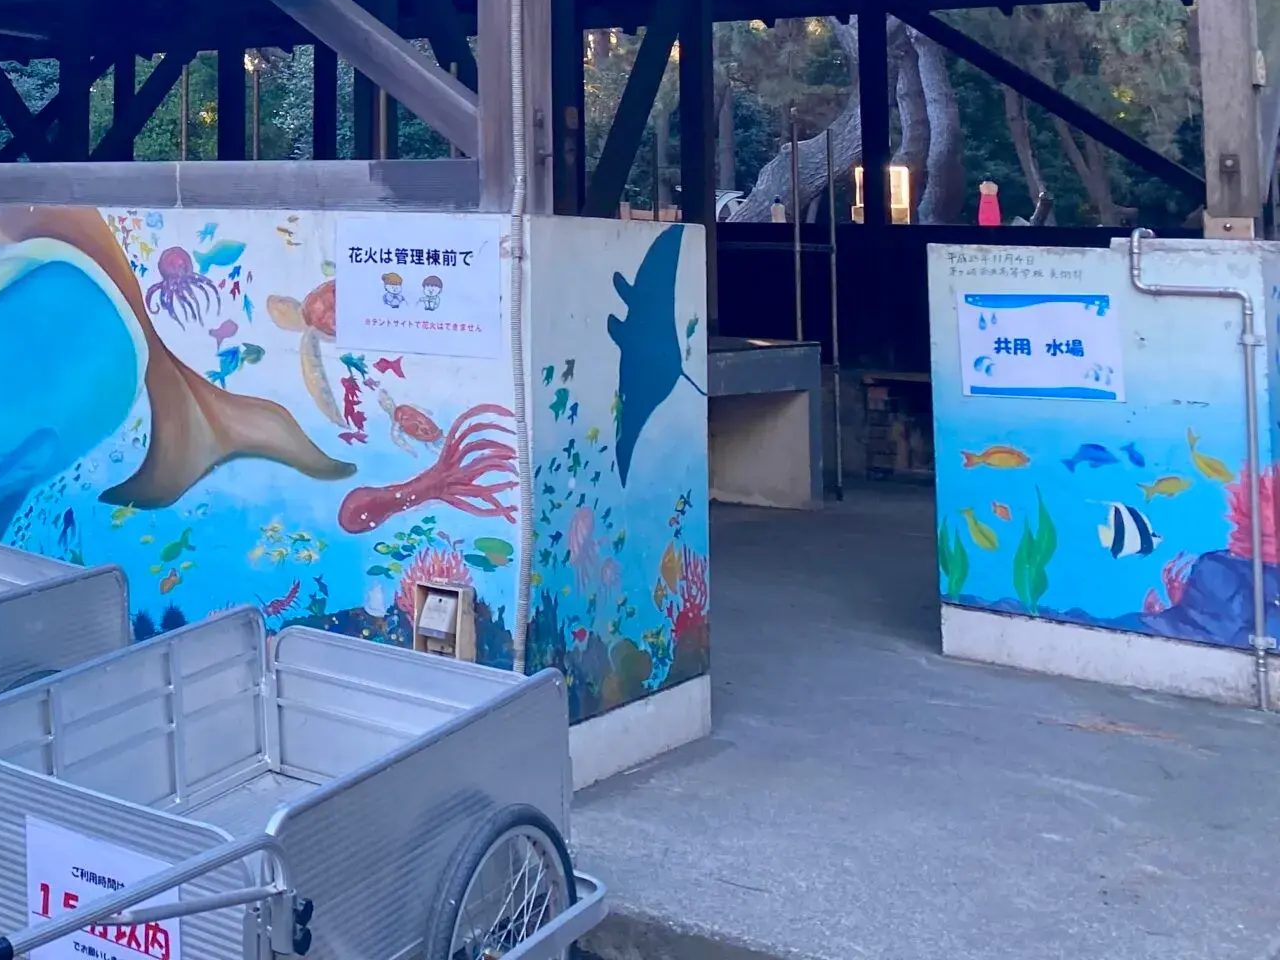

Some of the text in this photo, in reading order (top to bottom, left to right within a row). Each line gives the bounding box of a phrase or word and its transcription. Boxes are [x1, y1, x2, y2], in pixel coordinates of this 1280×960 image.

[348, 246, 474, 267] 花火は管理棟前で
[992, 337, 1085, 358] 共用 水場
